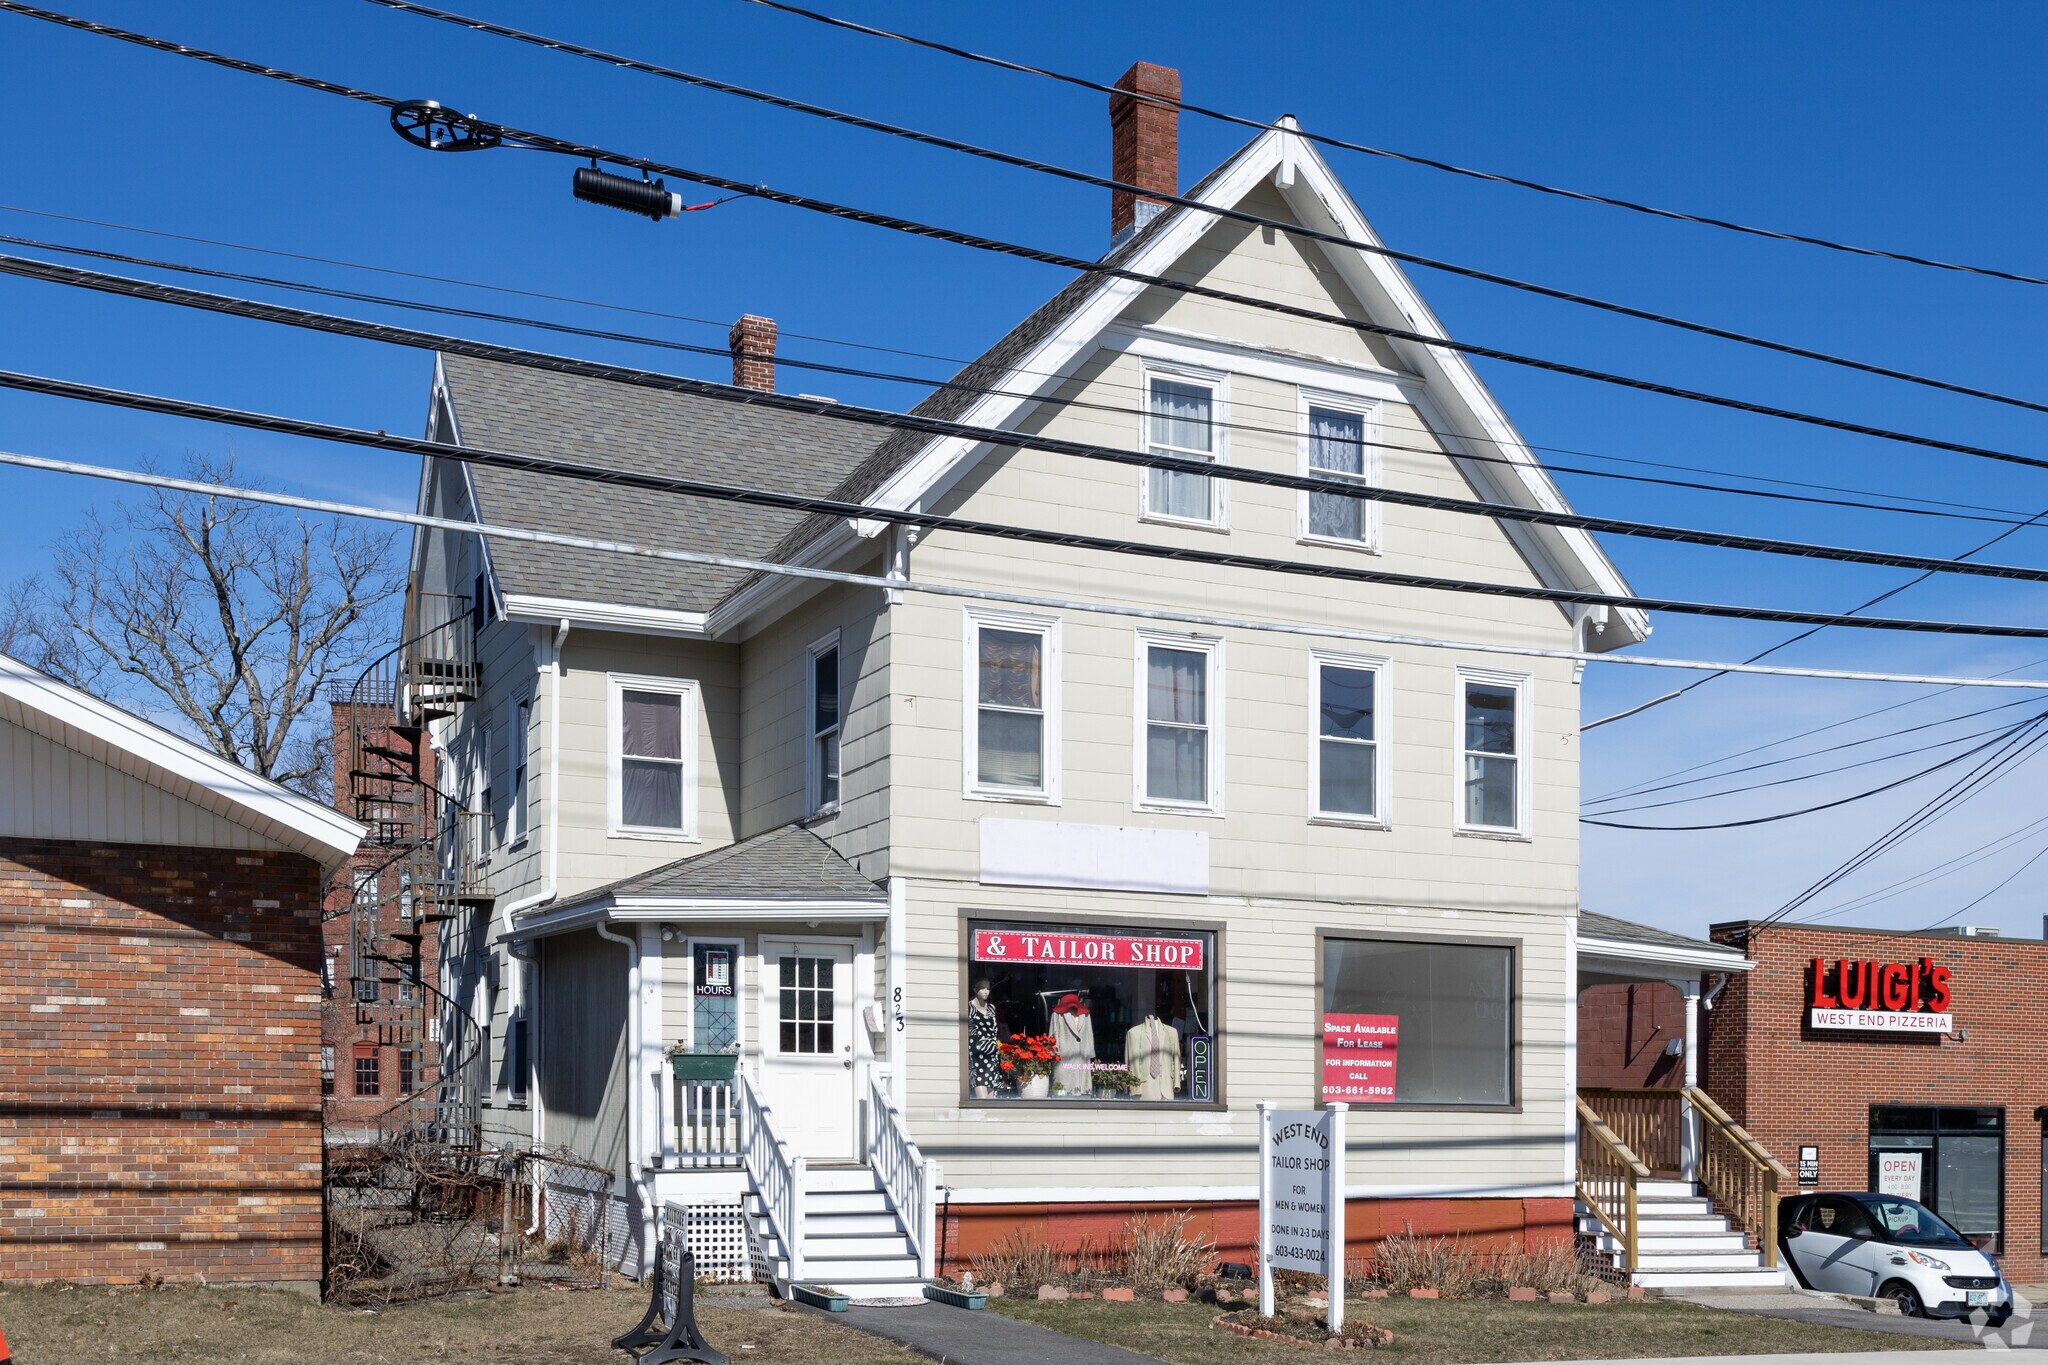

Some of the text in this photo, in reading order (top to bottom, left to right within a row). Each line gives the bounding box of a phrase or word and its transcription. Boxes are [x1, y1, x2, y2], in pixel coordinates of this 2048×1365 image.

[986, 936, 1195, 964] & TAILOR SHOP
[696, 985, 732, 995] HOURS
[1813, 957, 1953, 1013] LUIGI'S
[1817, 1013, 1947, 1028] WEST END PIZZERIA
[1324, 1022, 1397, 1034] SPACE AVAILABLE
[1337, 1038, 1383, 1049] FOR LEASE
[1095, 1063, 1128, 1071] WELCOME
[1194, 1040, 1209, 1098] OPEN
[1342, 1059, 1393, 1068] INFORMATION
[1322, 1085, 1394, 1095] 603-661-5962
[1272, 1123, 1329, 1150] WEST END
[1271, 1156, 1330, 1171] TAILOR SHOP
[1884, 1160, 1916, 1172] OPEN
[1799, 1170, 1818, 1178] ONLY
[1292, 1185, 1306, 1195] FOR
[1275, 1200, 1326, 1214] MEN & WOMEN
[1271, 1224, 1330, 1240] DONE IN 2-3 DAYS
[1275, 1245, 1326, 1262] 603-433-0024
